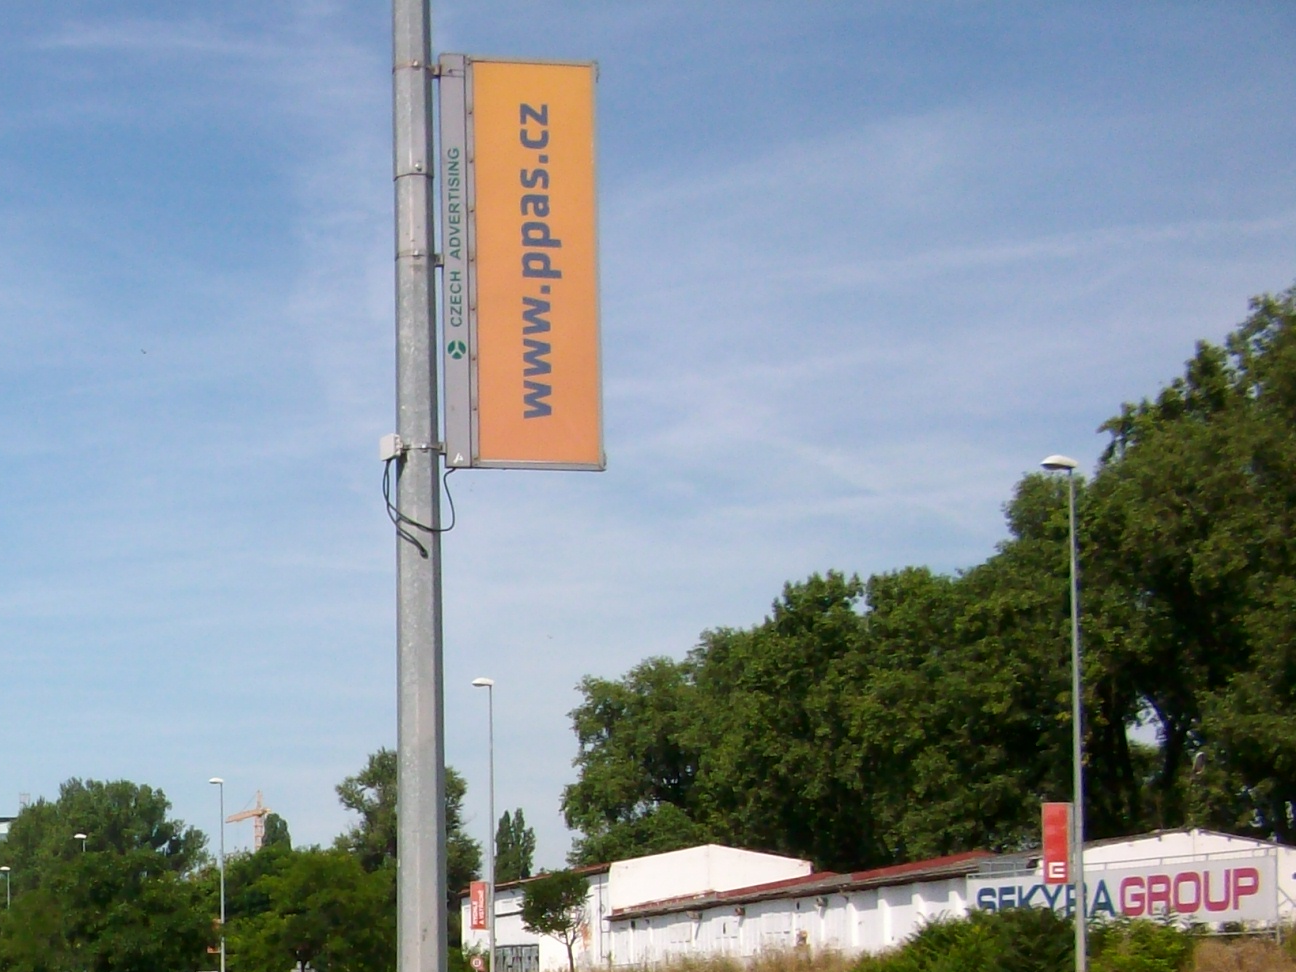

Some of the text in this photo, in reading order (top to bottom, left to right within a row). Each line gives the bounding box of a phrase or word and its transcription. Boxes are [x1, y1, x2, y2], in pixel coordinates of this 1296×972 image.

[446, 146, 463, 328] CZECH ADVERTISING
[519, 102, 563, 420] www.ppas.cz
